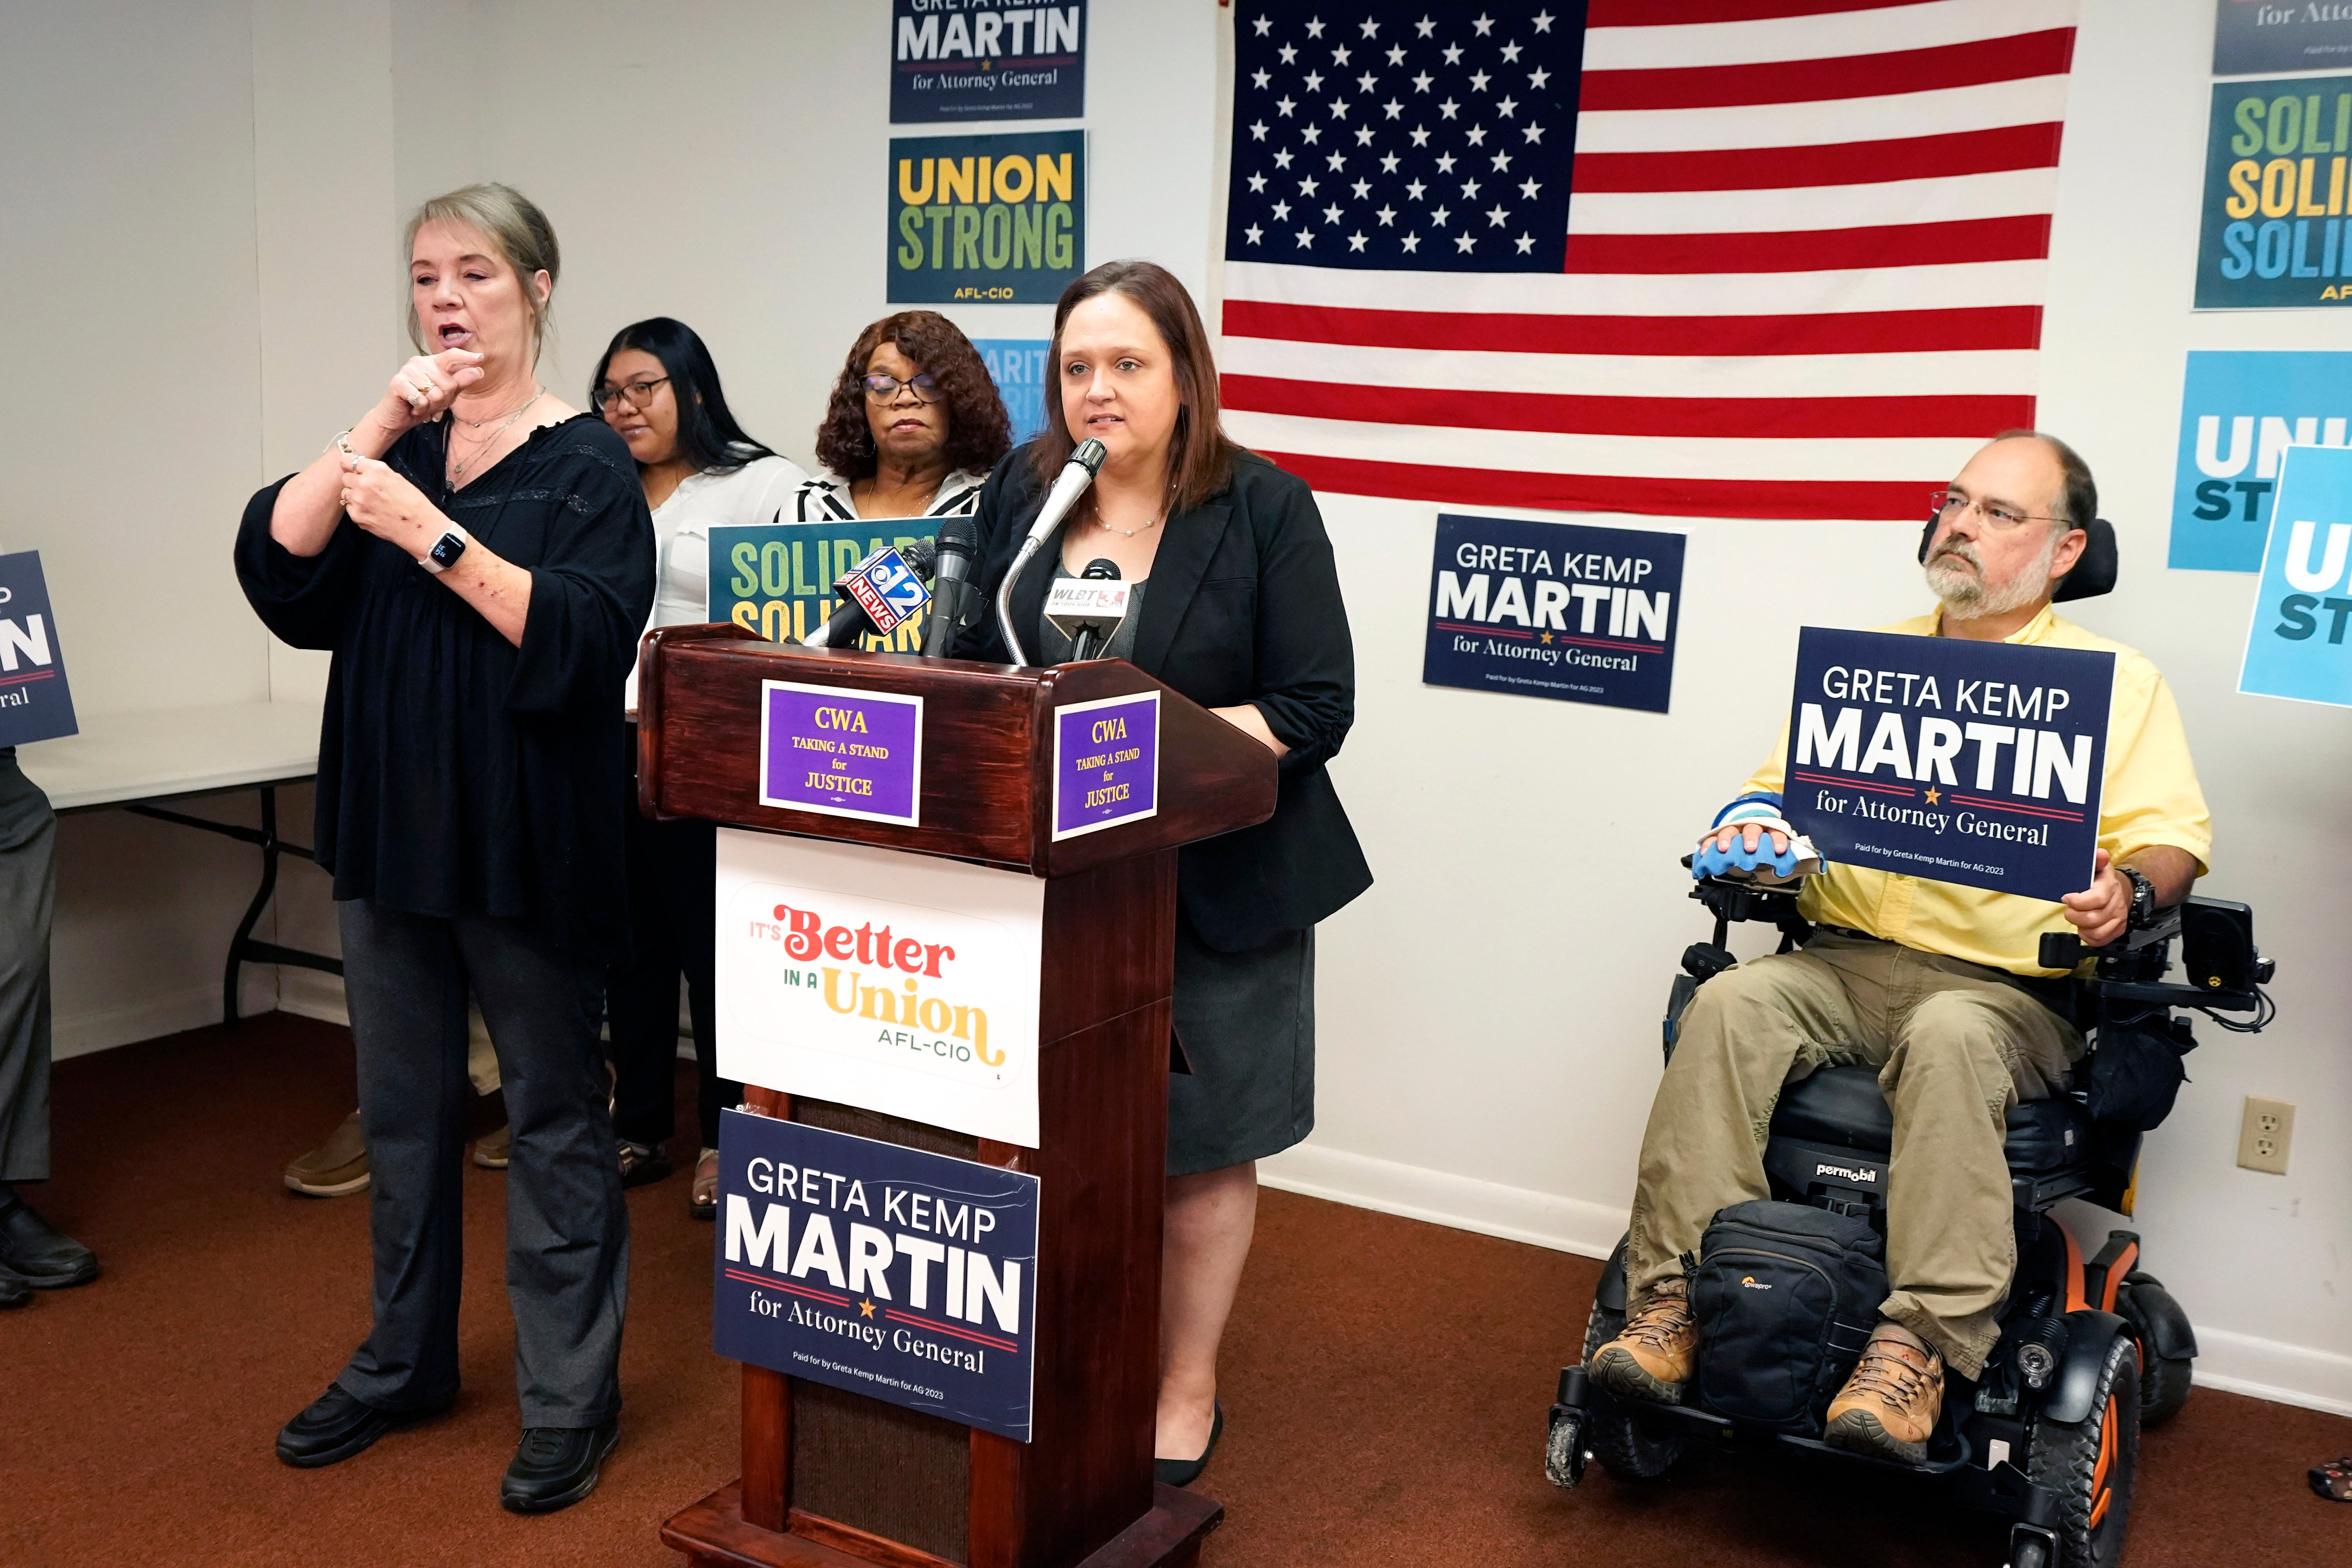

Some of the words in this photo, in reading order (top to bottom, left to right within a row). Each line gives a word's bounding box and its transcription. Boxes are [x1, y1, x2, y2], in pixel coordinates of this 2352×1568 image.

[897, 6, 1080, 61] MARTIN
[2256, 5, 2295, 26] for
[913, 74, 933, 90] for
[937, 70, 998, 91] Attorney
[1002, 69, 1058, 85] General
[898, 153, 1073, 205] UNION
[898, 202, 1073, 269] STRONG
[954, 287, 1014, 299] AFL-CIO
[1456, 543, 1553, 576] GRETA
[1563, 552, 1652, 584] KEMP
[852, 579, 895, 629] NEWS
[878, 565, 923, 618] 12
[1053, 589, 1098, 601] WLBT
[1435, 570, 1670, 641] MARTIN
[1453, 635, 1479, 653] for
[1483, 639, 1561, 666] Attorney
[1565, 648, 1638, 672] General
[1823, 666, 1942, 709] GRETA
[1956, 679, 2070, 722] KEMP
[815, 706, 868, 733] CWA
[1092, 717, 1127, 744] CWA
[792, 736, 835, 753] TAKING
[838, 742, 846, 754] A
[849, 744, 889, 759] STAND
[831, 758, 847, 770] for
[1076, 754, 1106, 771] TAKING
[1107, 753, 1113, 764] A
[1114, 748, 1140, 763] STAND
[1795, 702, 2093, 804] MARTIN
[805, 772, 872, 796] JUSTICE
[1085, 783, 1129, 808] JUSTICE
[1103, 771, 1113, 782] for
[1815, 790, 1848, 814] for
[1852, 796, 1950, 835] Attorney
[1956, 811, 2048, 846] General
[1855, 843, 1870, 852] Paid
[1871, 845, 1882, 854] for
[1883, 847, 1892, 857] by
[1893, 850, 1913, 860] Greta
[1914, 853, 1934, 864] Kemp
[1936, 857, 1959, 867] Martin
[1960, 860, 1972, 869] for
[1973, 864, 1984, 872] AG
[1985, 866, 2004, 875] 2023
[773, 904, 955, 979] Better
[784, 969, 800, 987] IN
[807, 972, 817, 989] A
[821, 967, 1006, 1067] Union
[878, 1029, 971, 1063] AFL-CIO
[1816, 1164, 1876, 1182] permobil
[747, 1158, 870, 1217] GRETA
[884, 1187, 996, 1244] KEMP
[725, 1193, 1021, 1334] MARTIN
[749, 1291, 782, 1318] for
[787, 1301, 886, 1351] Attorney
[893, 1328, 984, 1374] General
[793, 1351, 808, 1362] Paid
[809, 1355, 820, 1365] for
[822, 1358, 831, 1370] by
[832, 1362, 852, 1374] Greta
[854, 1368, 874, 1381] Kemp
[875, 1374, 899, 1388] Martin
[901, 1381, 912, 1390] for
[913, 1384, 924, 1394] AG
[925, 1388, 944, 1400] 2023
